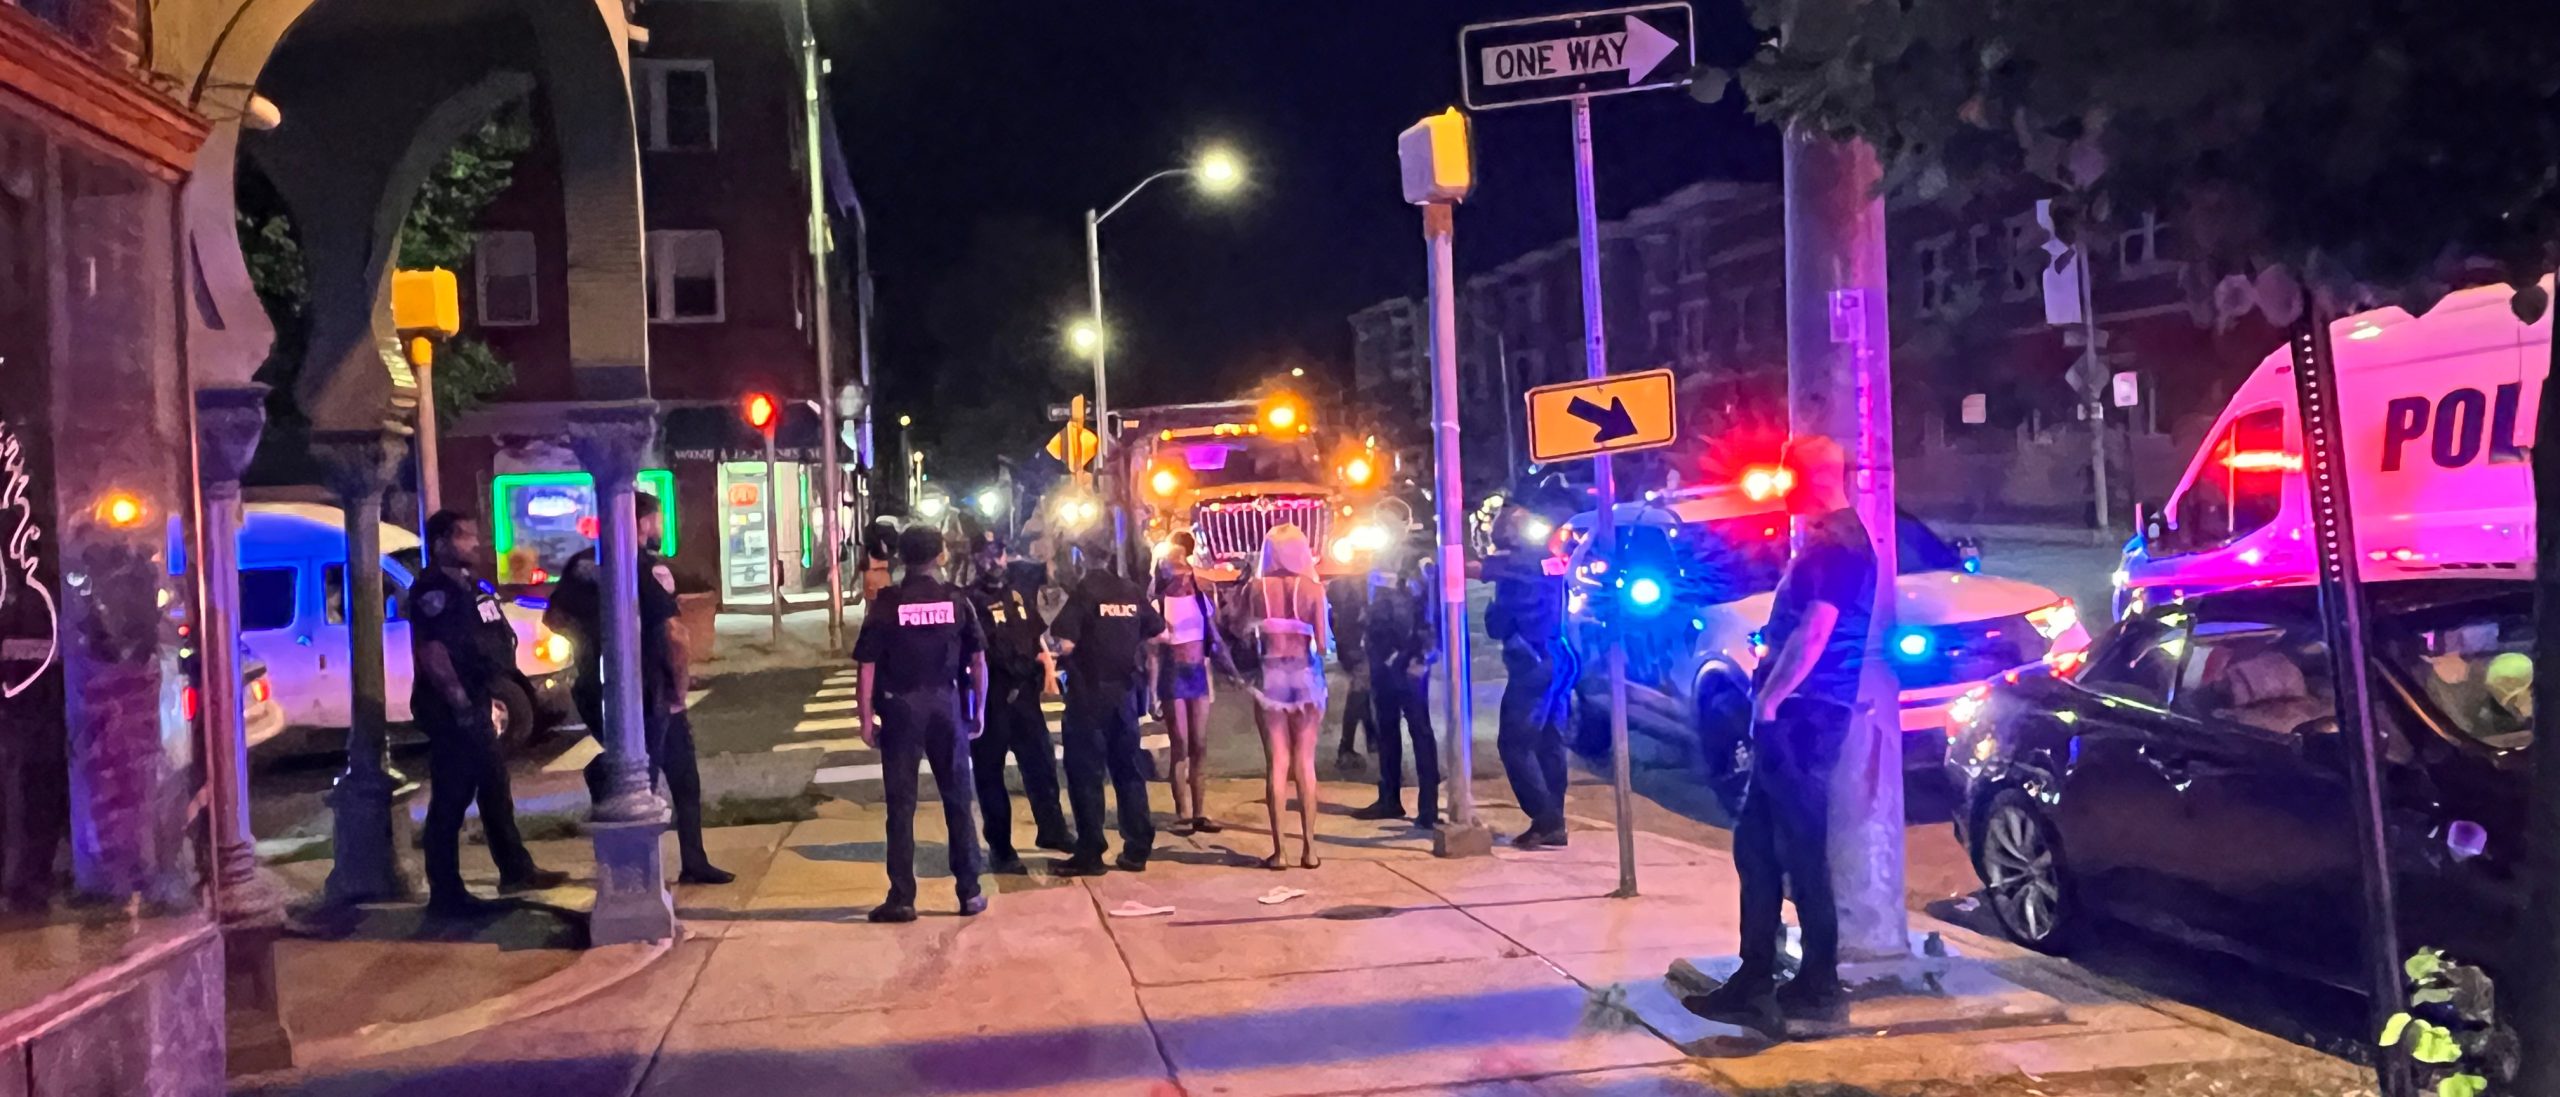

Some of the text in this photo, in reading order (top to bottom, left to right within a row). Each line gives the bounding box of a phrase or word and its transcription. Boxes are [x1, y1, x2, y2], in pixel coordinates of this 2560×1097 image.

[1495, 35, 1628, 80] ONE WAY
[2381, 381, 2525, 472] POL
